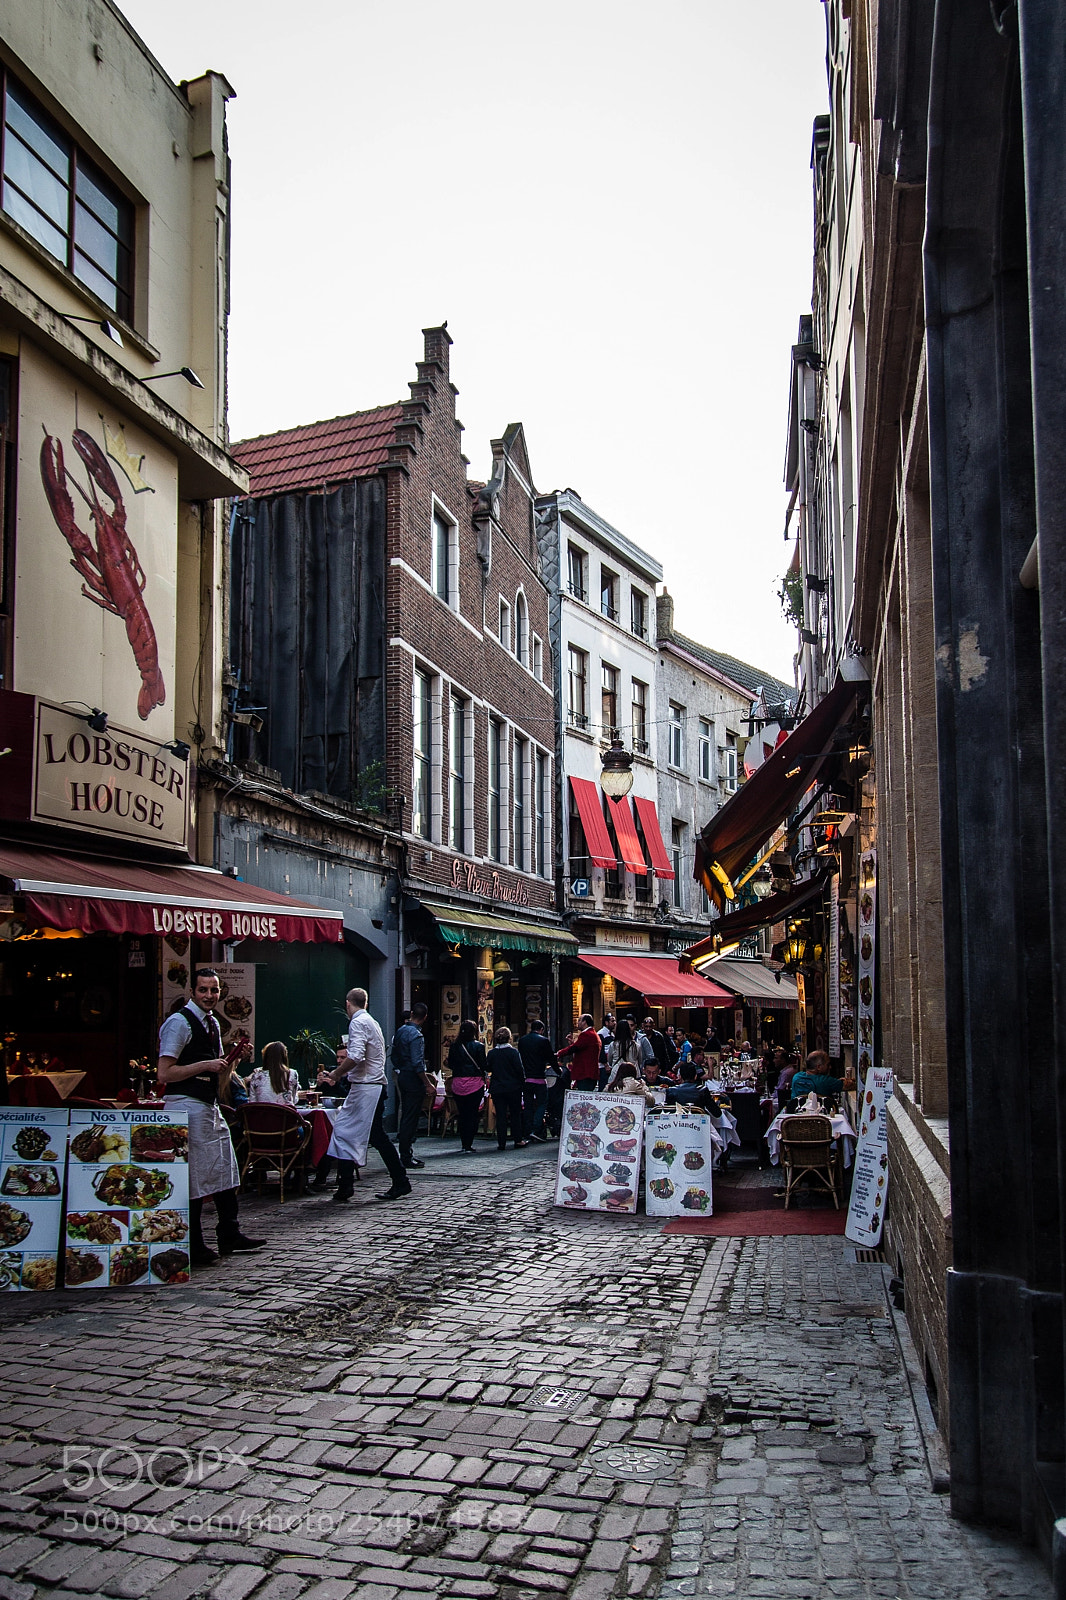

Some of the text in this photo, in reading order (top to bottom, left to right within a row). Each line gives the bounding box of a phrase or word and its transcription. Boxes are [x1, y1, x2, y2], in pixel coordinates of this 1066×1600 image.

[42, 732, 185, 801] LOBSTER
[69, 781, 165, 832] HOUSE
[576, 881, 587, 895] P
[152, 908, 278, 938] LOBSTER HOUSE
[90, 1111, 171, 1123] Nos Viandes
[657, 1121, 701, 1132] Nos Viandes
